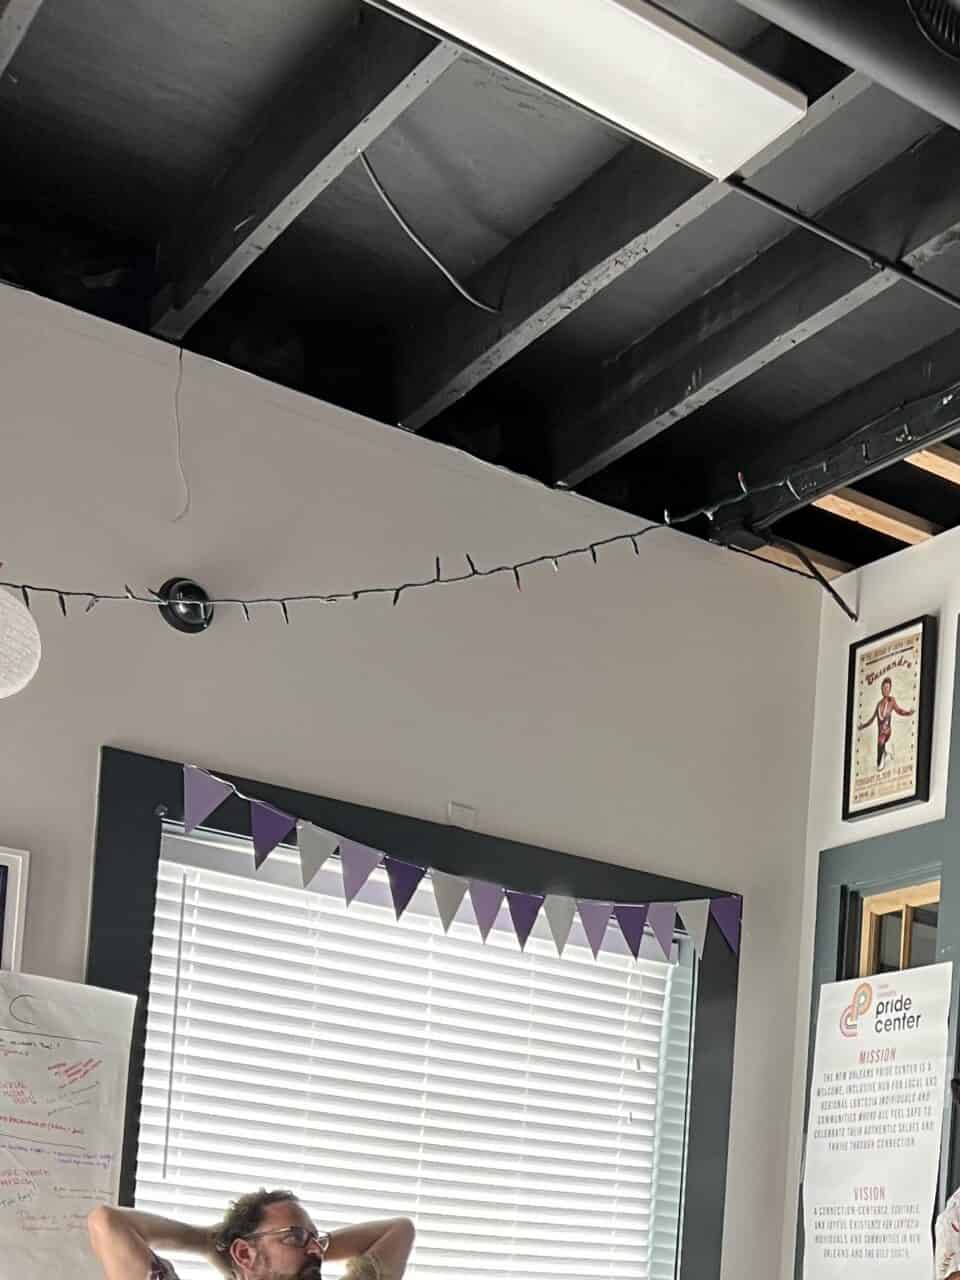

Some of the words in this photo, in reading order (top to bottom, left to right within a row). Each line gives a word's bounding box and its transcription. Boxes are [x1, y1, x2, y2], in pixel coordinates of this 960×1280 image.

[876, 994, 912, 1019] pride
[875, 1012, 920, 1033] center
[859, 1048, 896, 1064] MISSION
[854, 1185, 886, 1200] VISION
